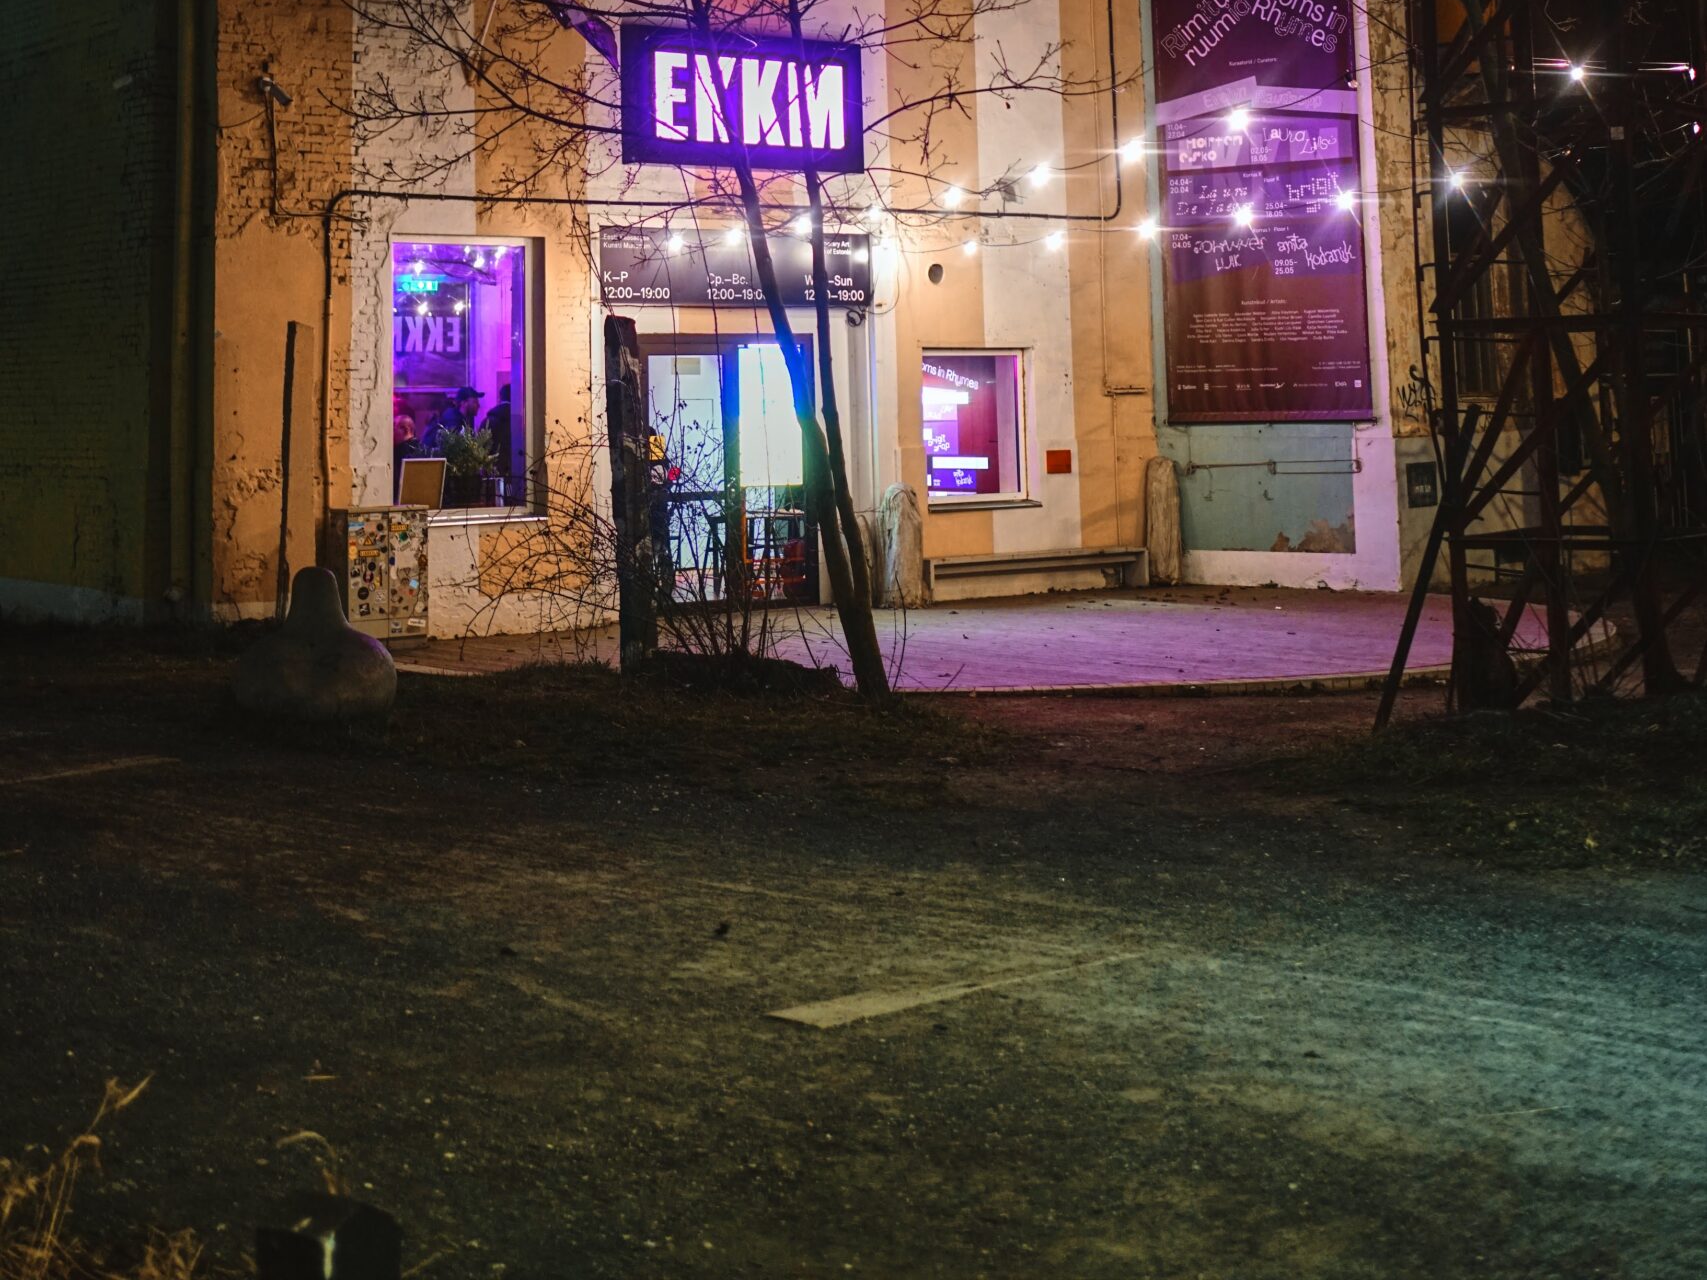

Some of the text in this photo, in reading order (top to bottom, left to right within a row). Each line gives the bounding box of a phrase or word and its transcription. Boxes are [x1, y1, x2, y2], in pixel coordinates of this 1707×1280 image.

[1325, 5, 1348, 34] in
[604, 271, 629, 283] K–P
[804, 275, 853, 287] W–Sun
[604, 287, 671, 299] 12:00–19:00
